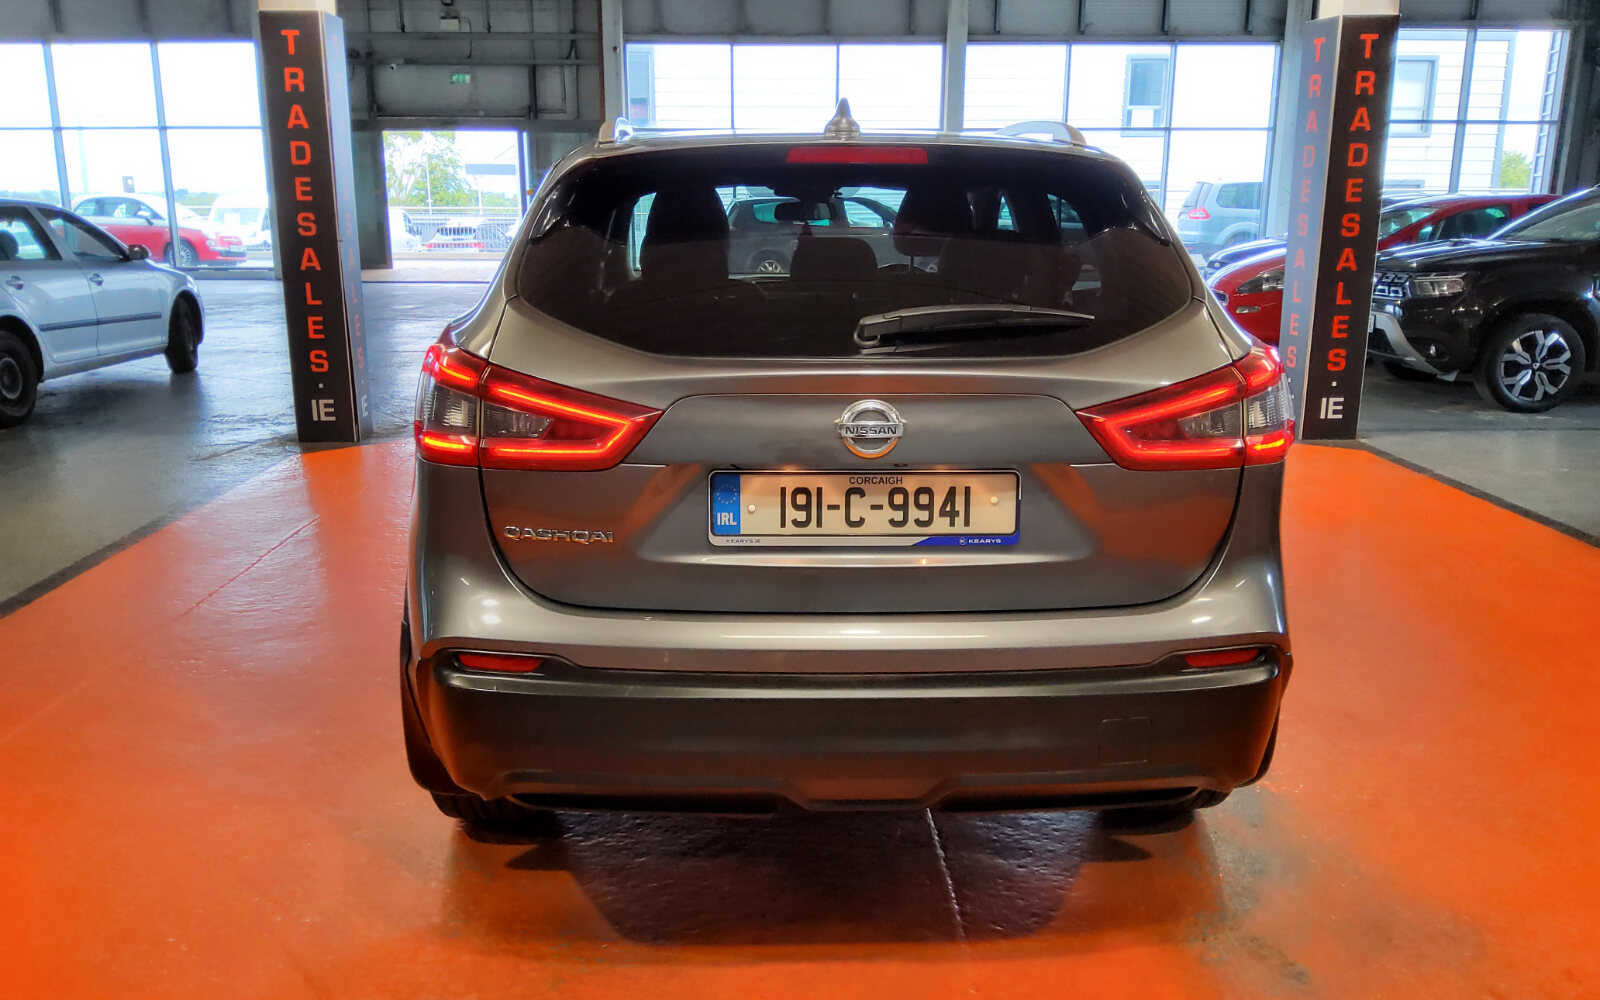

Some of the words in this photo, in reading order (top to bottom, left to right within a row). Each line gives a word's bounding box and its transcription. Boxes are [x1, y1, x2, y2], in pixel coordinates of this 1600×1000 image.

[845, 426, 897, 435] NISSAN
[849, 476, 903, 485] CORCAIGH
[780, 486, 971, 528] 191-C-9941
[717, 512, 737, 526] IRL
[504, 526, 614, 544] QASHQAI
